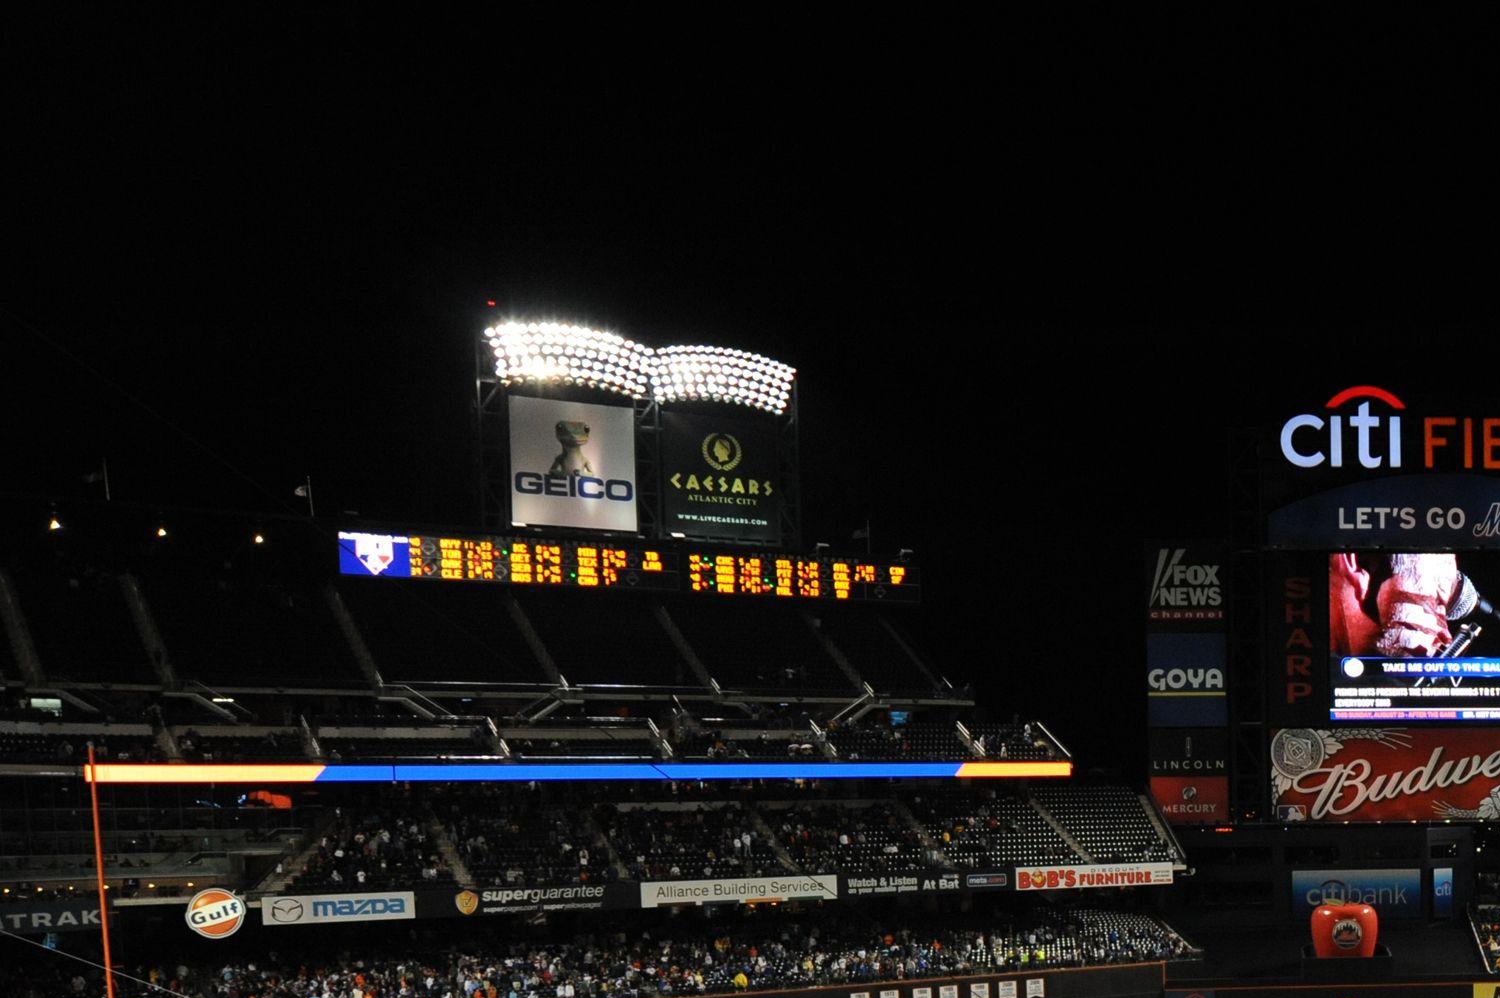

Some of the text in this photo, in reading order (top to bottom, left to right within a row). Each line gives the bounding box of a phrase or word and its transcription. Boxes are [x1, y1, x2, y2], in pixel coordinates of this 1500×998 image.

[1280, 402, 1401, 469] citi
[514, 471, 634, 501] GEICO
[670, 472, 773, 497] CAESARS
[688, 493, 758, 506] ATLANTIC CITY
[677, 513, 768, 526] WWW.LIVECAESARS.COM
[1338, 506, 1416, 531] LET'S
[1426, 507, 1466, 530] GO
[1173, 565, 1220, 586] FOX
[1160, 587, 1222, 607] NEWS
[1151, 610, 1223, 619] channel
[1284, 576, 1313, 704] SHARP
[1382, 663, 1406, 673] TAKE
[1408, 663, 1422, 673] ME
[1424, 663, 1445, 673] OUT
[1446, 663, 1460, 673] TO
[1462, 663, 1480, 673] THE
[1148, 668, 1223, 690] GOYA
[1153, 760, 1225, 769] LINCOLN
[1162, 803, 1217, 814] MERCURY
[848, 877, 918, 888] Watch & Listen
[923, 878, 960, 890] At Bat
[1018, 869, 1152, 889] BOB'S FURNITURE
[1435, 881, 1452, 896] citi
[482, 886, 604, 903] superguarantee
[656, 881, 825, 898] Alliance Building Services
[190, 900, 240, 926] Gulf
[312, 894, 405, 918] mazda
[0, 910, 102, 929] TRAK
